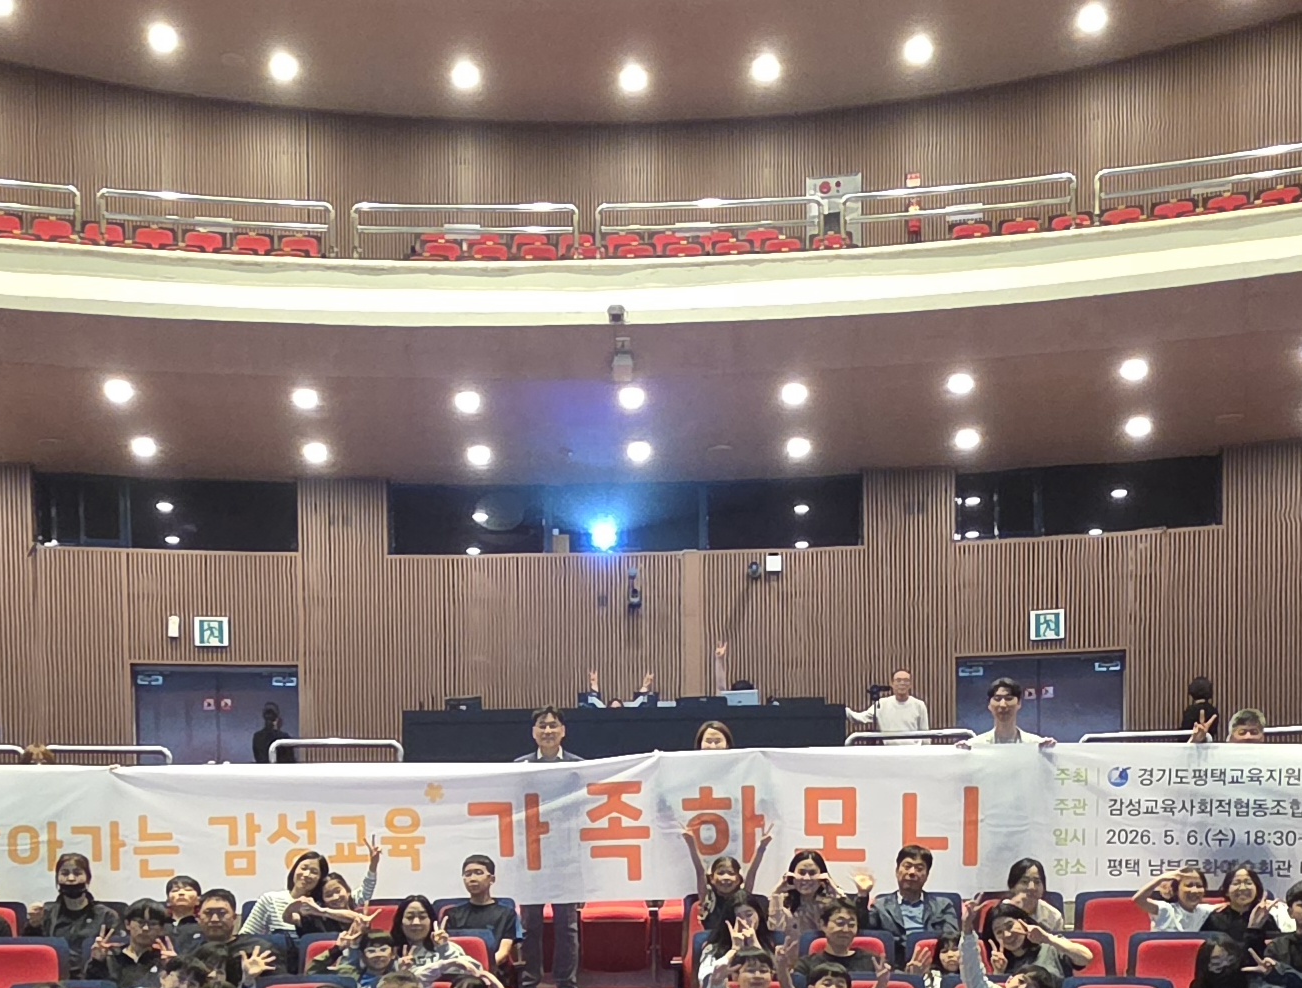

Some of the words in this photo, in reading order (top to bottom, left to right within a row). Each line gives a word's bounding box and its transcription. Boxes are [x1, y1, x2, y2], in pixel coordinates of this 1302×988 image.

[1054, 767, 1088, 786] 주최
[1053, 798, 1088, 816] 주관
[208, 808, 427, 878] 감성교육
[1052, 828, 1086, 846] 일시
[1105, 829, 1156, 846] 2026.
[1163, 830, 1179, 846] 5.
[1052, 858, 1087, 877] 장소
[1107, 858, 1140, 877] 평택
